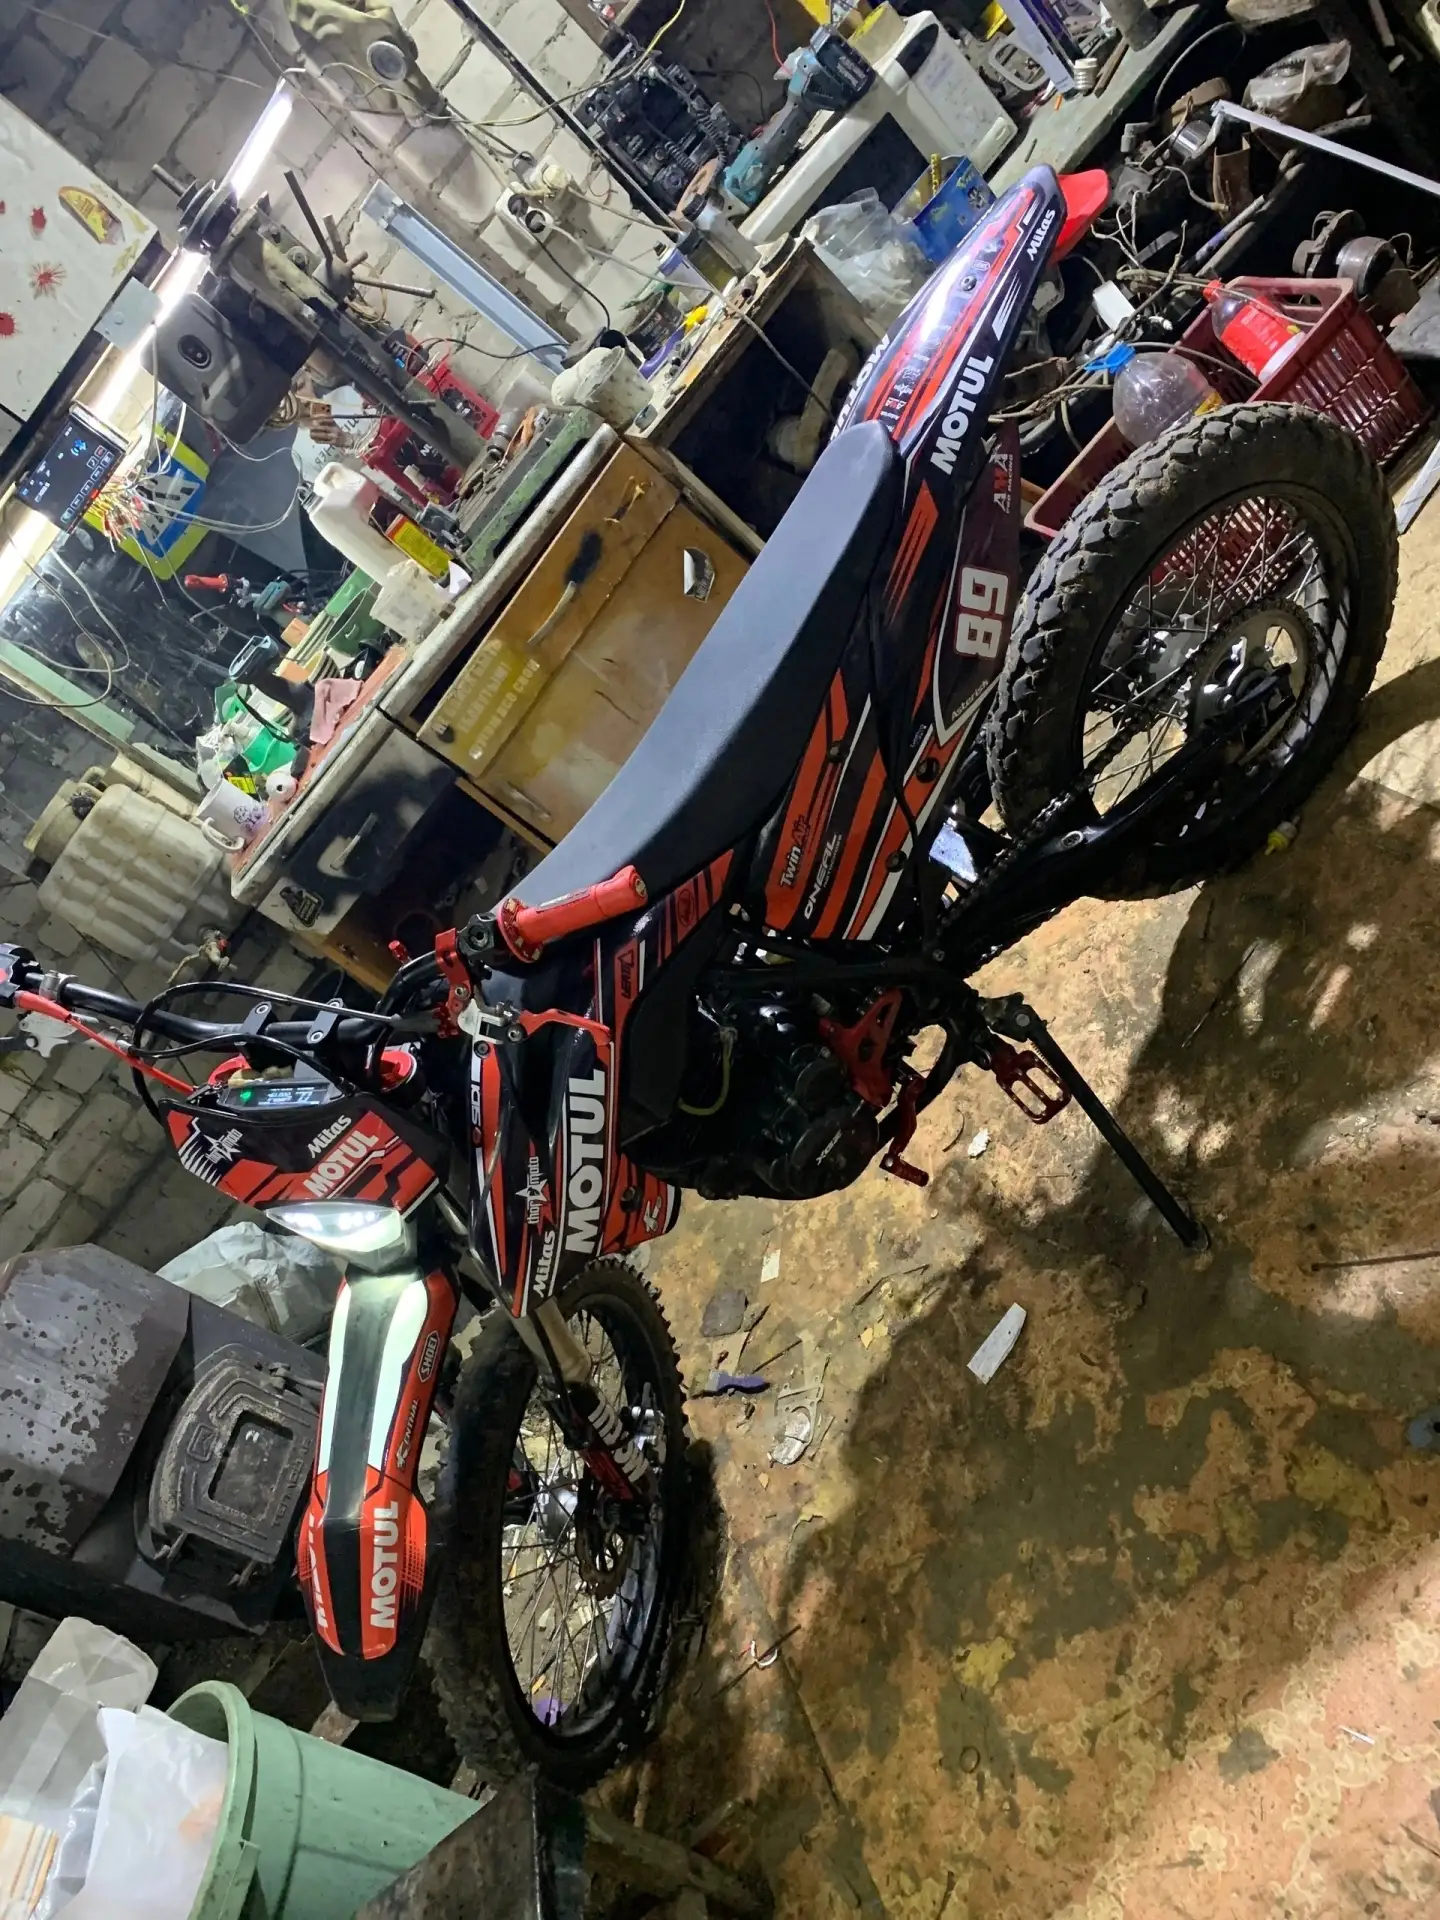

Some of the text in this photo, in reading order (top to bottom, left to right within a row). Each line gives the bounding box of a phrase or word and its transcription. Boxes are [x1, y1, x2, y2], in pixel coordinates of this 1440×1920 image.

[1027, 209, 1056, 261] Mitas
[930, 355, 995, 475] MOTUL
[956, 566, 1009, 658] 89
[780, 846, 801, 888] Twin
[303, 1130, 379, 1197] MOTUL
[307, 1115, 352, 1158] Mitas
[565, 1068, 606, 1254] MOTUL
[533, 1230, 556, 1298] Mitas
[421, 1336, 437, 1376] SHOEI
[370, 1501, 399, 1629] MOTUL
